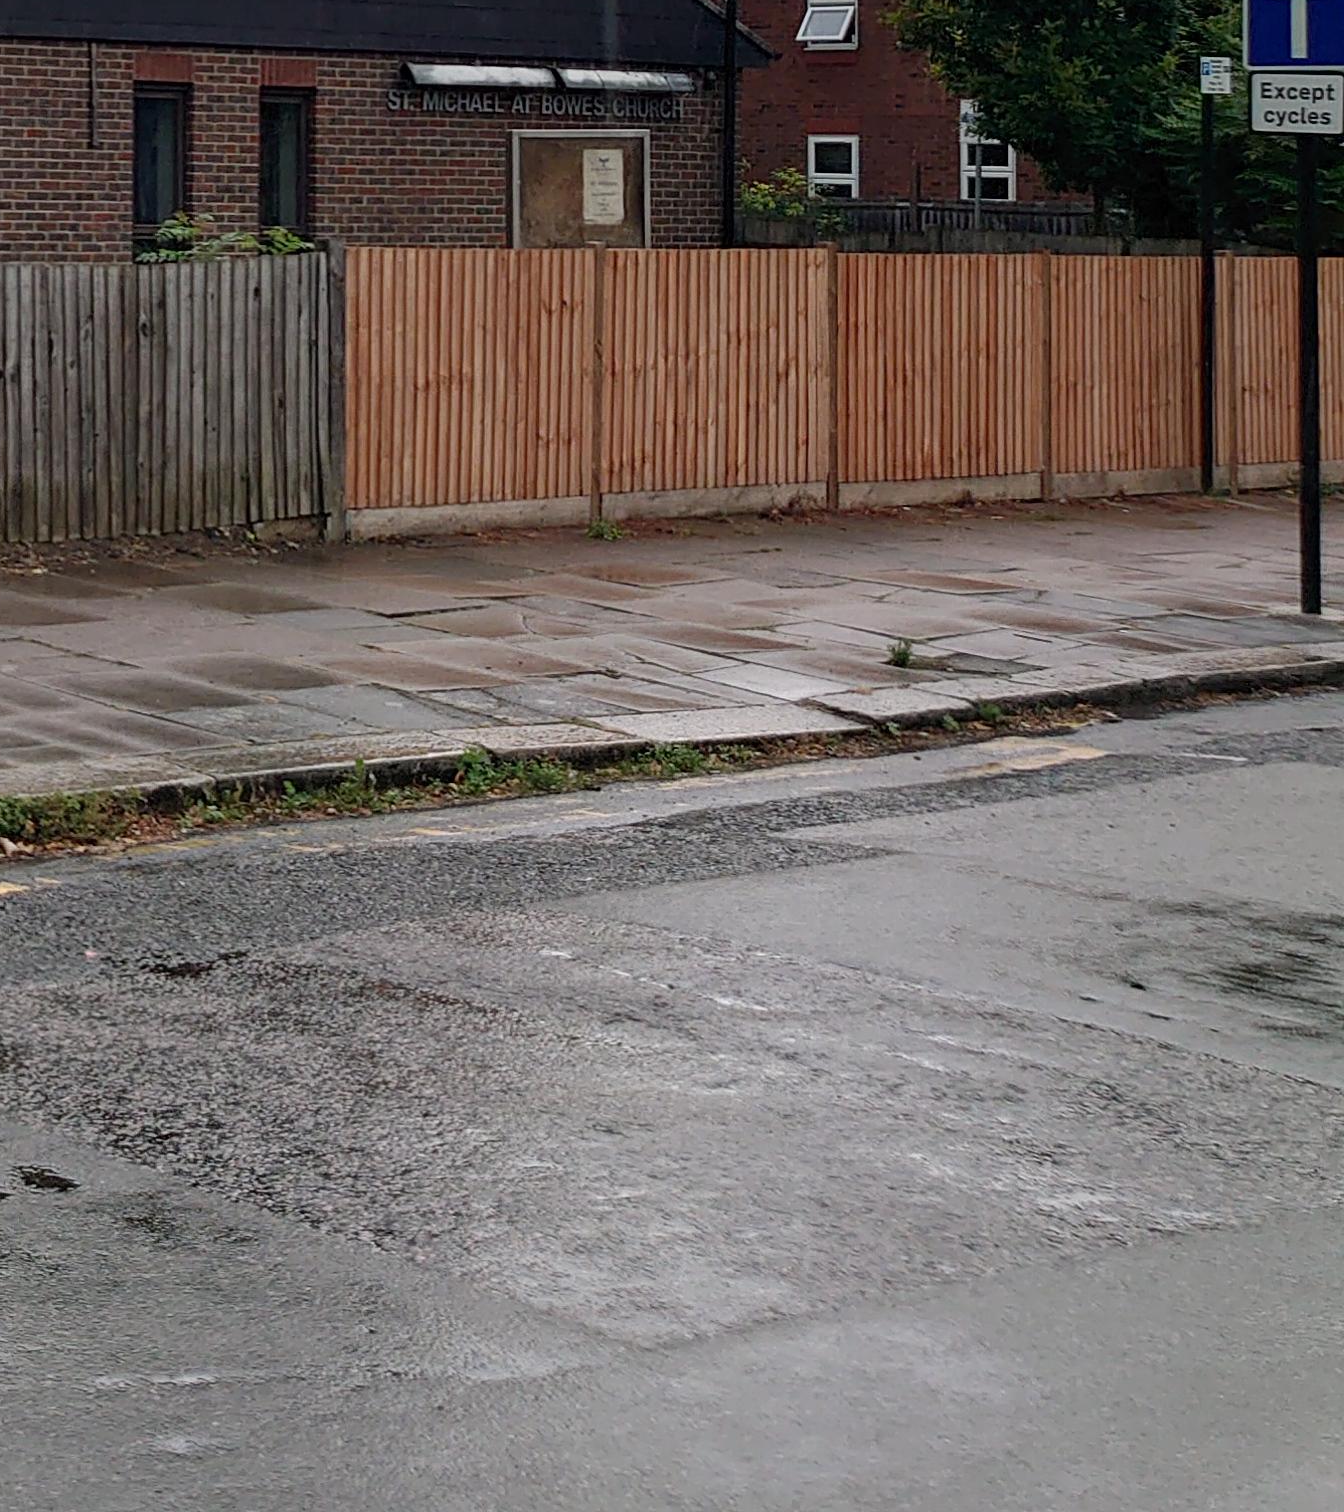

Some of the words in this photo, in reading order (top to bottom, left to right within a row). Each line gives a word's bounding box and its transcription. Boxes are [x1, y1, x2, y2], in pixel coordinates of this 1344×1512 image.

[387, 89, 414, 110] ST.
[423, 90, 504, 113] MICHAEL
[512, 93, 536, 114] AT
[542, 94, 605, 116] BOWES
[612, 95, 684, 119] CHURCH
[1260, 82, 1335, 104] Except
[1264, 107, 1331, 127] cycles
